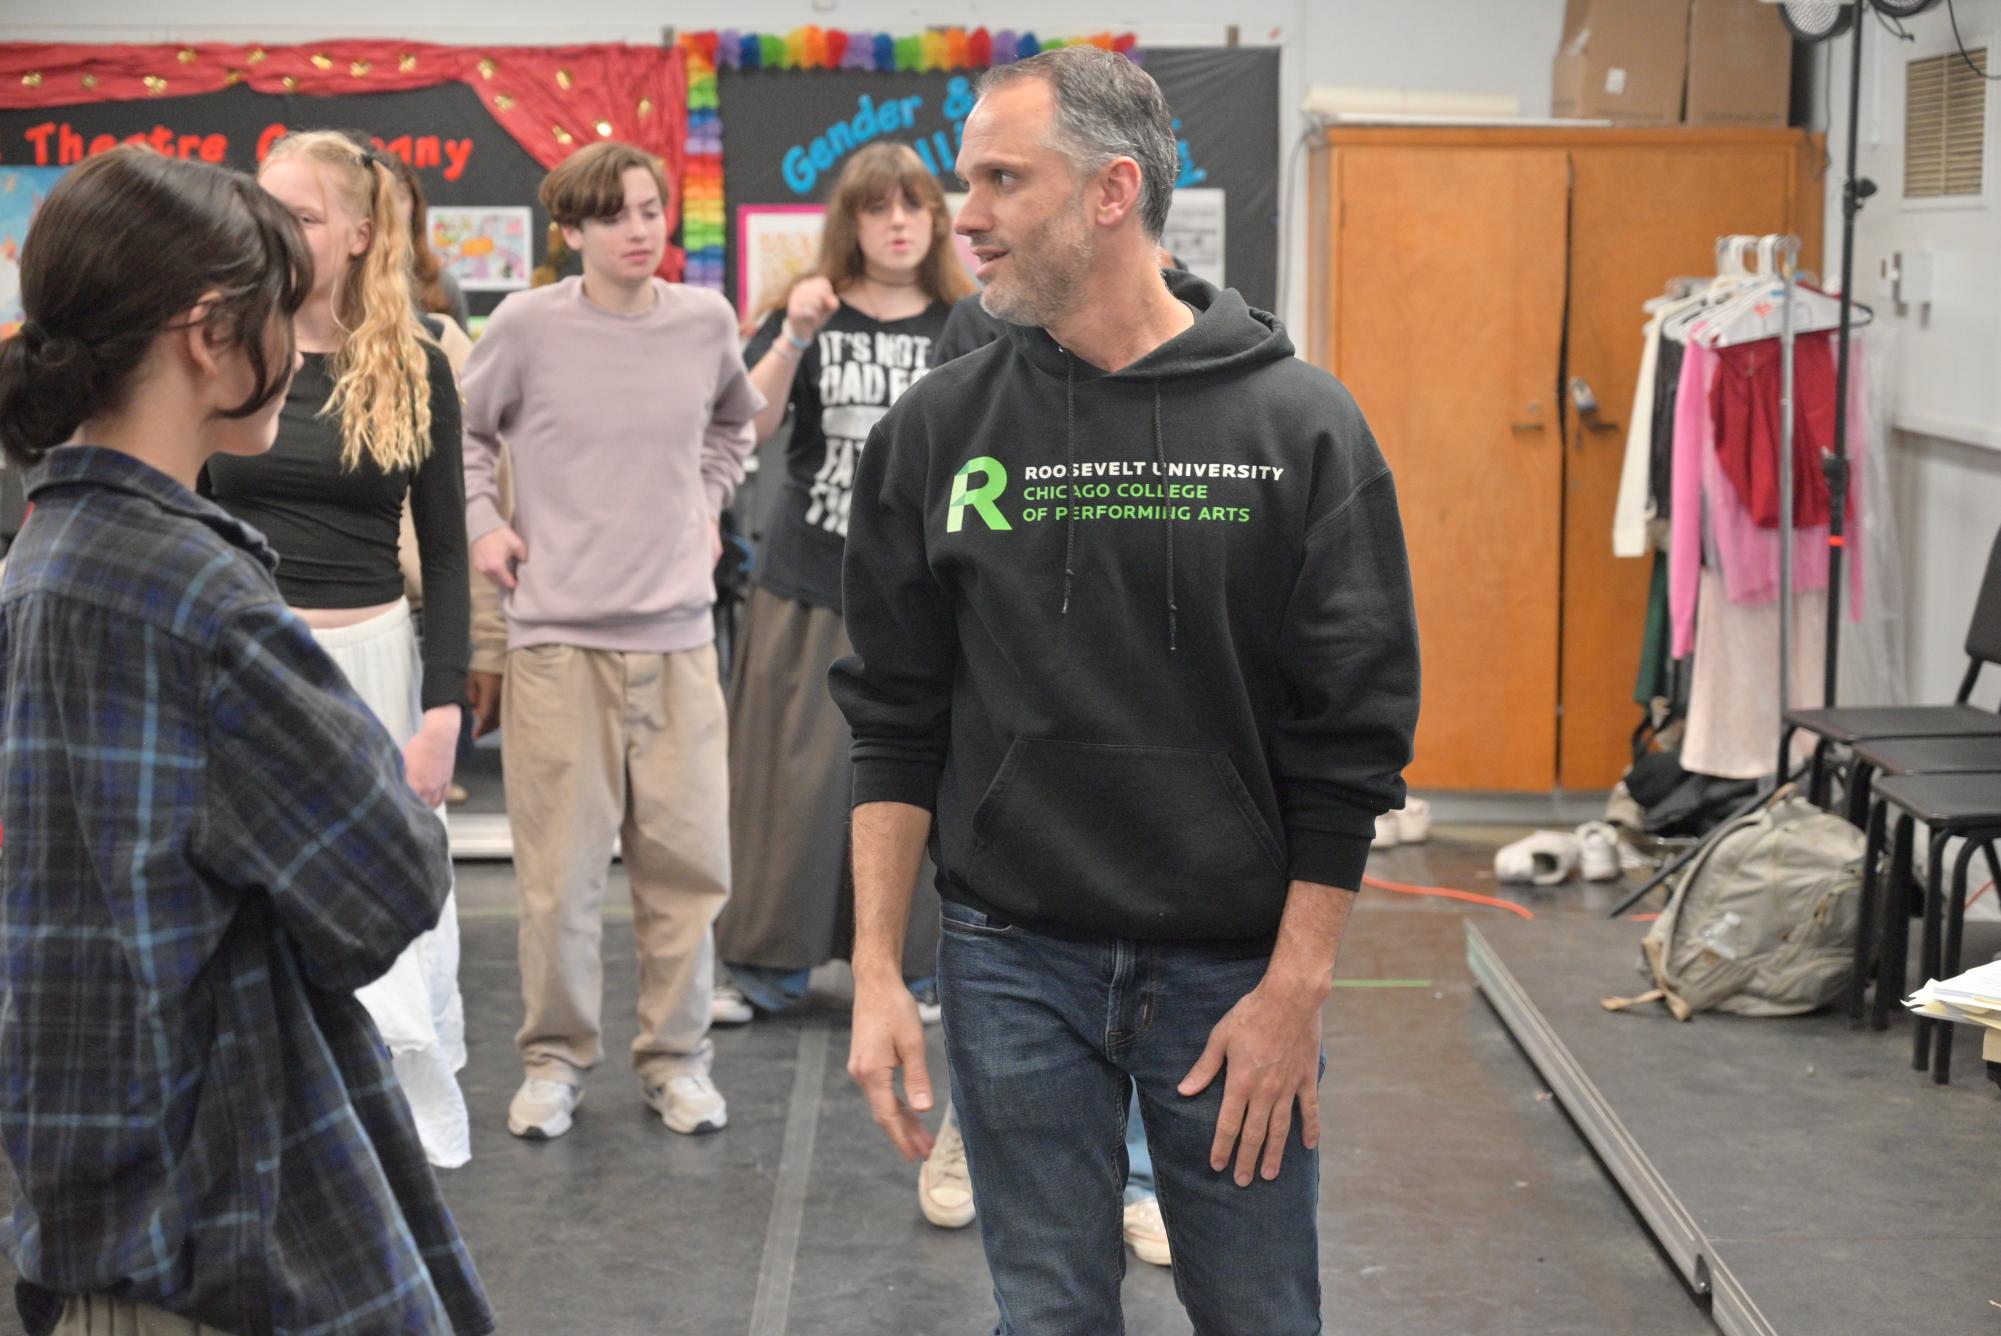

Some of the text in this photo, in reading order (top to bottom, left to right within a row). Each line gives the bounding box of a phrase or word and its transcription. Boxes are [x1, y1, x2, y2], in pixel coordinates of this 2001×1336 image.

[781, 94, 923, 194] Gender
[818, 330, 931, 368] IT'S NOT
[1025, 461, 1284, 480] ROOSEVELT UNIVERSITY
[1023, 483, 1208, 500] CHICAGO COLLEGE
[1022, 505, 1250, 522] OF PERFORMING ARTS
